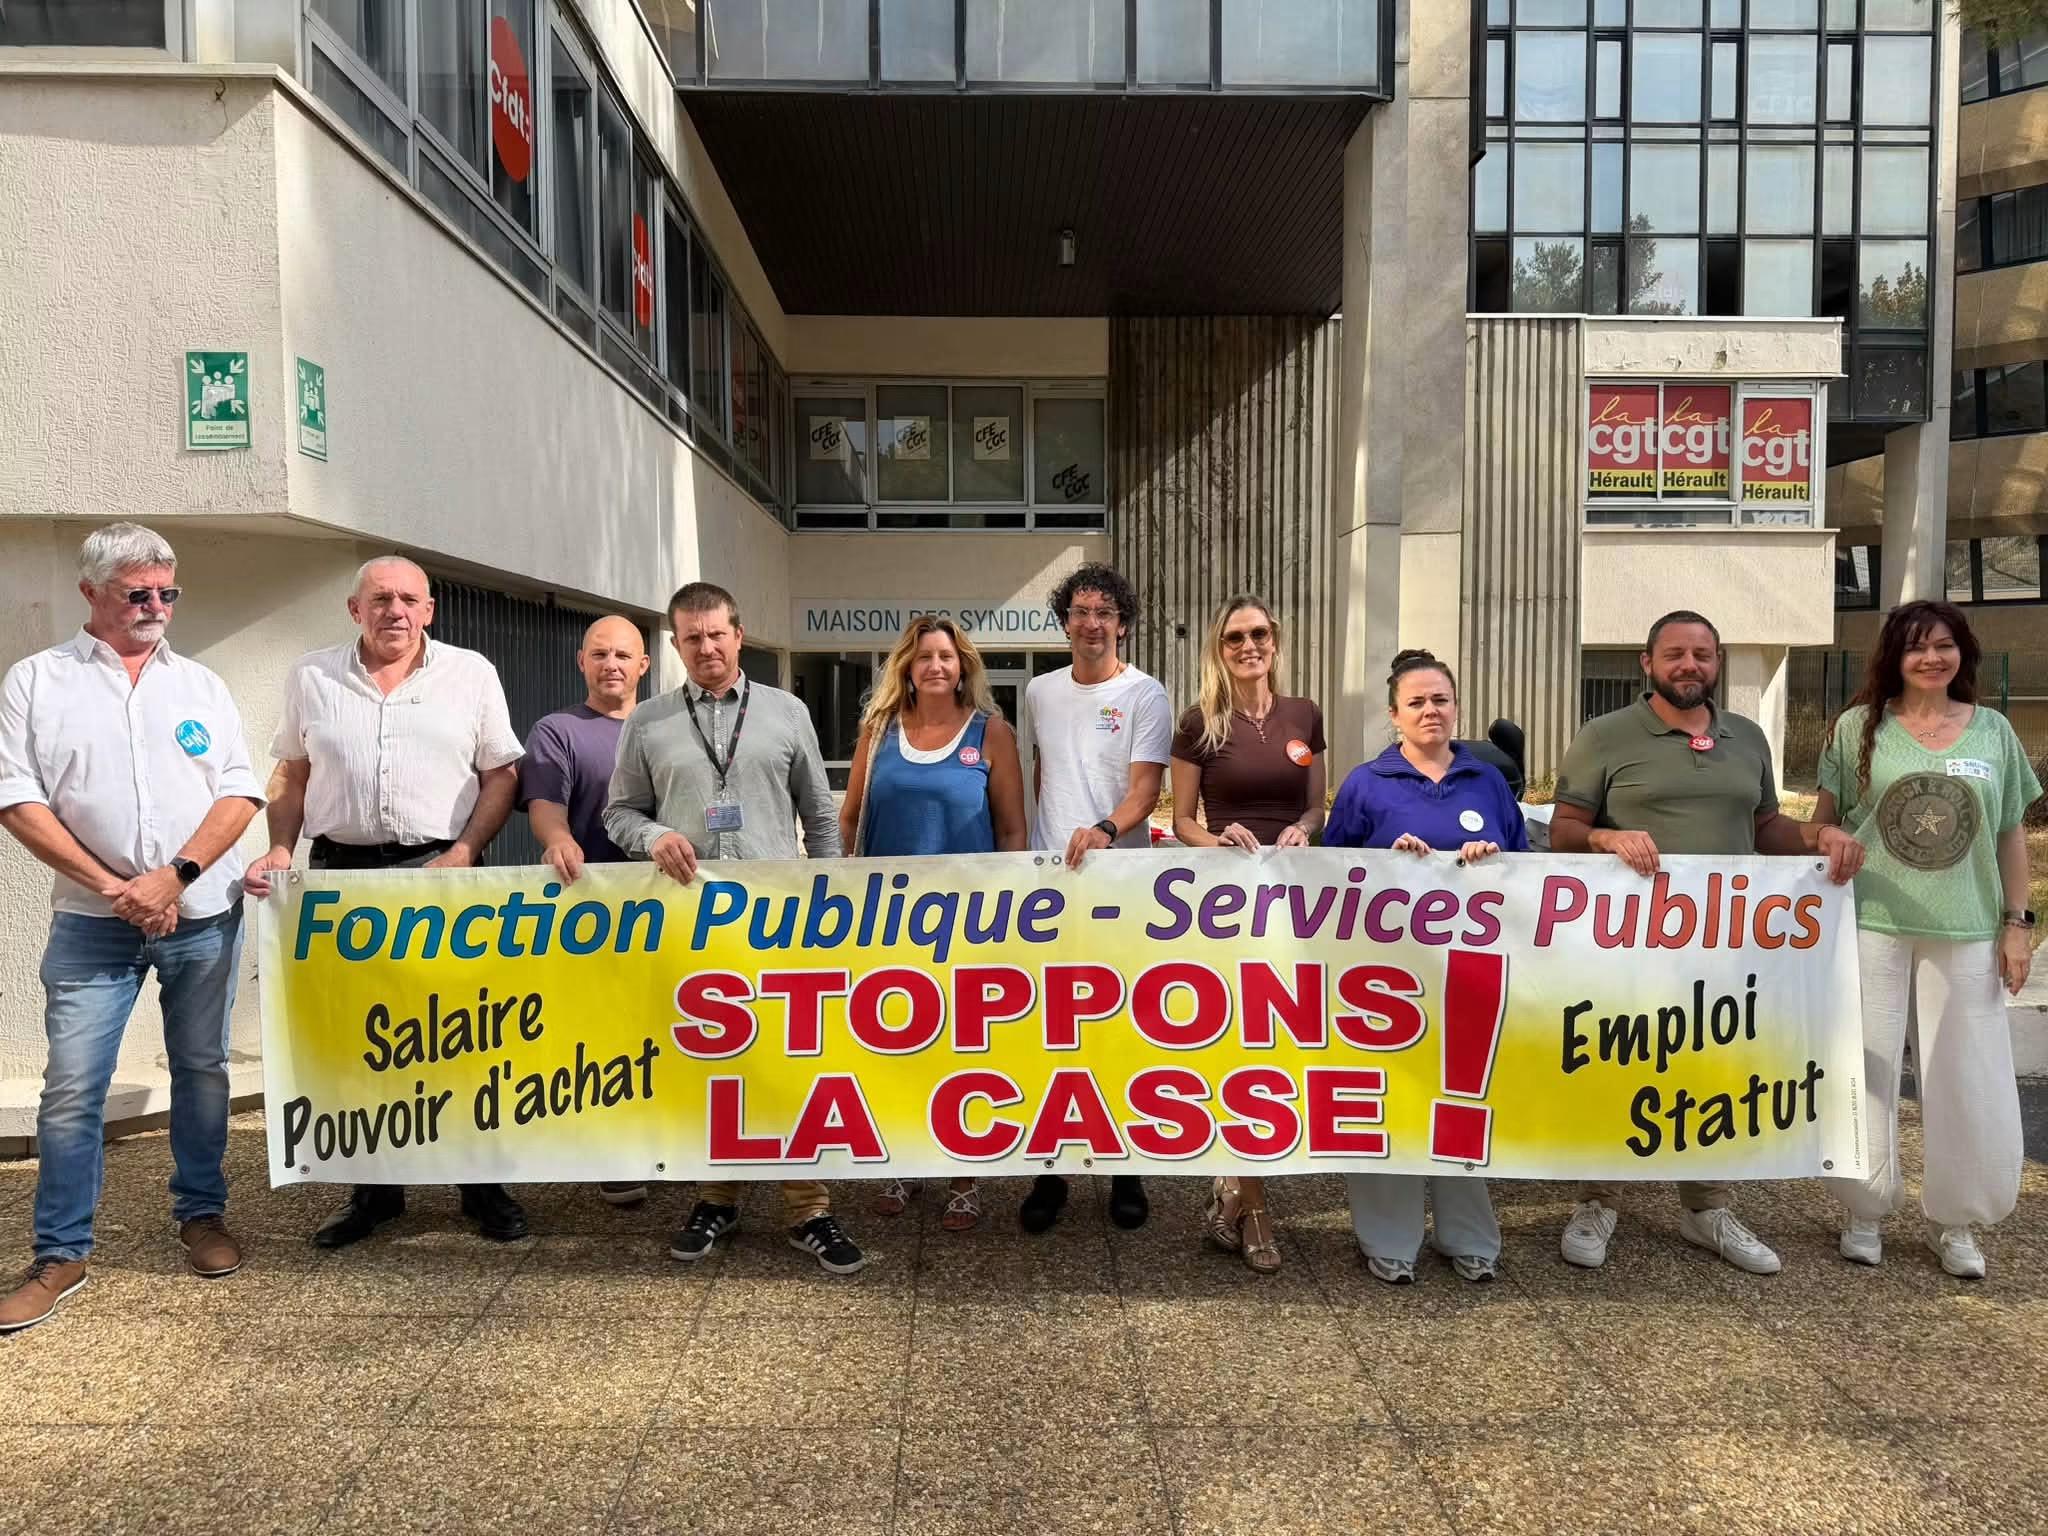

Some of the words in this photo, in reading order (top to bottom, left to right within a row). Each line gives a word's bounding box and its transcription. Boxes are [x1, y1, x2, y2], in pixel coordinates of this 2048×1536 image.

[1592, 395, 1645, 424] la
[1665, 395, 1718, 424] la
[1745, 408, 1798, 436] la
[811, 422, 832, 442] CFE
[906, 430, 927, 450] CGC
[975, 422, 994, 442] CFE
[984, 430, 1007, 450] CGC
[1589, 416, 1657, 464] cgt
[1663, 416, 1729, 464] cgt
[1743, 429, 1809, 476] cgt
[1052, 464, 1079, 490] CFE
[1064, 473, 1091, 500] CGC
[1590, 471, 1653, 488] Hérault
[1663, 471, 1727, 488] Hérault
[1743, 484, 1805, 500] Hérault
[807, 609, 900, 632] MAISON
[960, 609, 1060, 632] SYNDICA
[960, 752, 979, 763] cgt
[294, 882, 665, 961] Fonction
[691, 873, 1066, 963] Publique
[1091, 906, 1121, 919] -
[1146, 866, 1505, 947] Services
[1533, 871, 1823, 949] Publics
[671, 960, 1428, 1059] STOPPONS
[1561, 973, 1758, 1074] Emploi
[363, 987, 545, 1073] Salaire
[283, 1081, 454, 1169] Pouvoir
[474, 1037, 661, 1132] d'achat
[706, 1070, 889, 1165] LA
[926, 1064, 1390, 1162] CASSE
[1626, 1060, 1825, 1157] Statut
